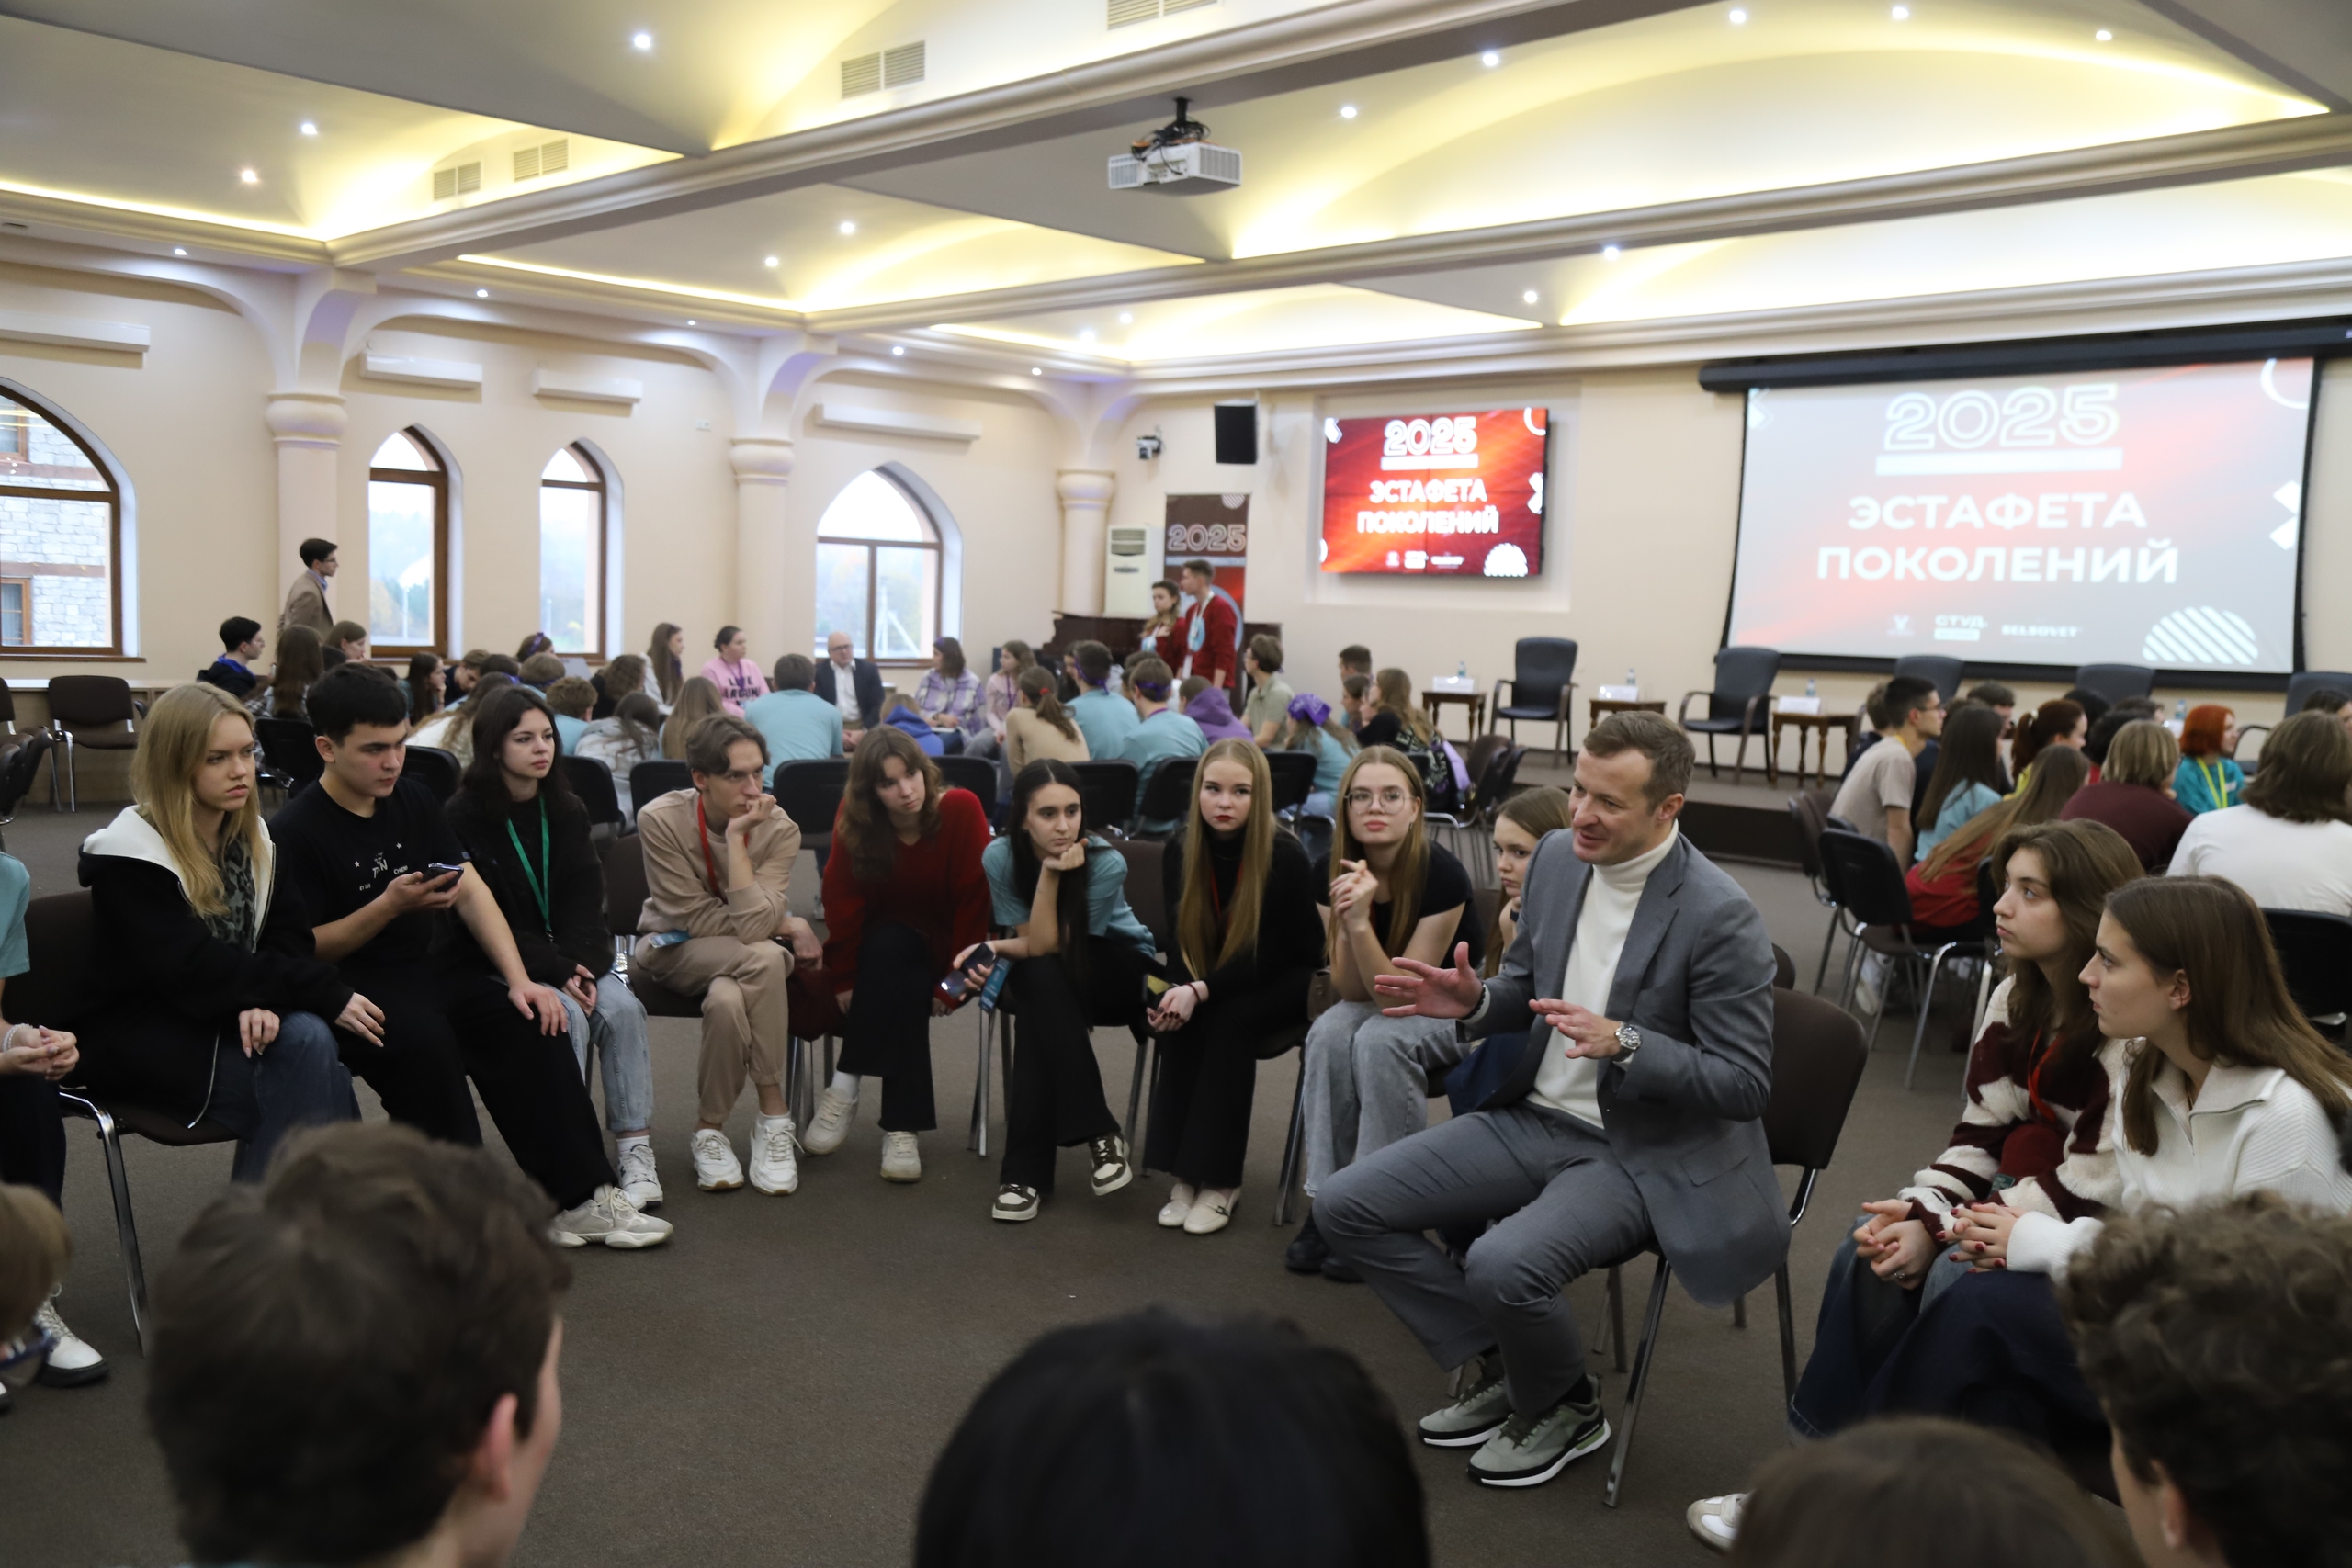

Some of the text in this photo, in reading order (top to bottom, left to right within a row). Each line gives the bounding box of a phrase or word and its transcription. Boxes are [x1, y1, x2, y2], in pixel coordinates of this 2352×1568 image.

[1383, 416, 1478, 457] 2025
[1884, 383, 2119, 451] 2025
[1369, 478, 1488, 503] ЭСТАФЕТА
[1356, 504, 1500, 535] ПОКОЛЕНИЙ
[1847, 492, 2148, 532] ЭСТАФЕТА
[1167, 523, 1247, 553] 2025
[1816, 538, 2178, 584] ПОКОЛЕНИЙ
